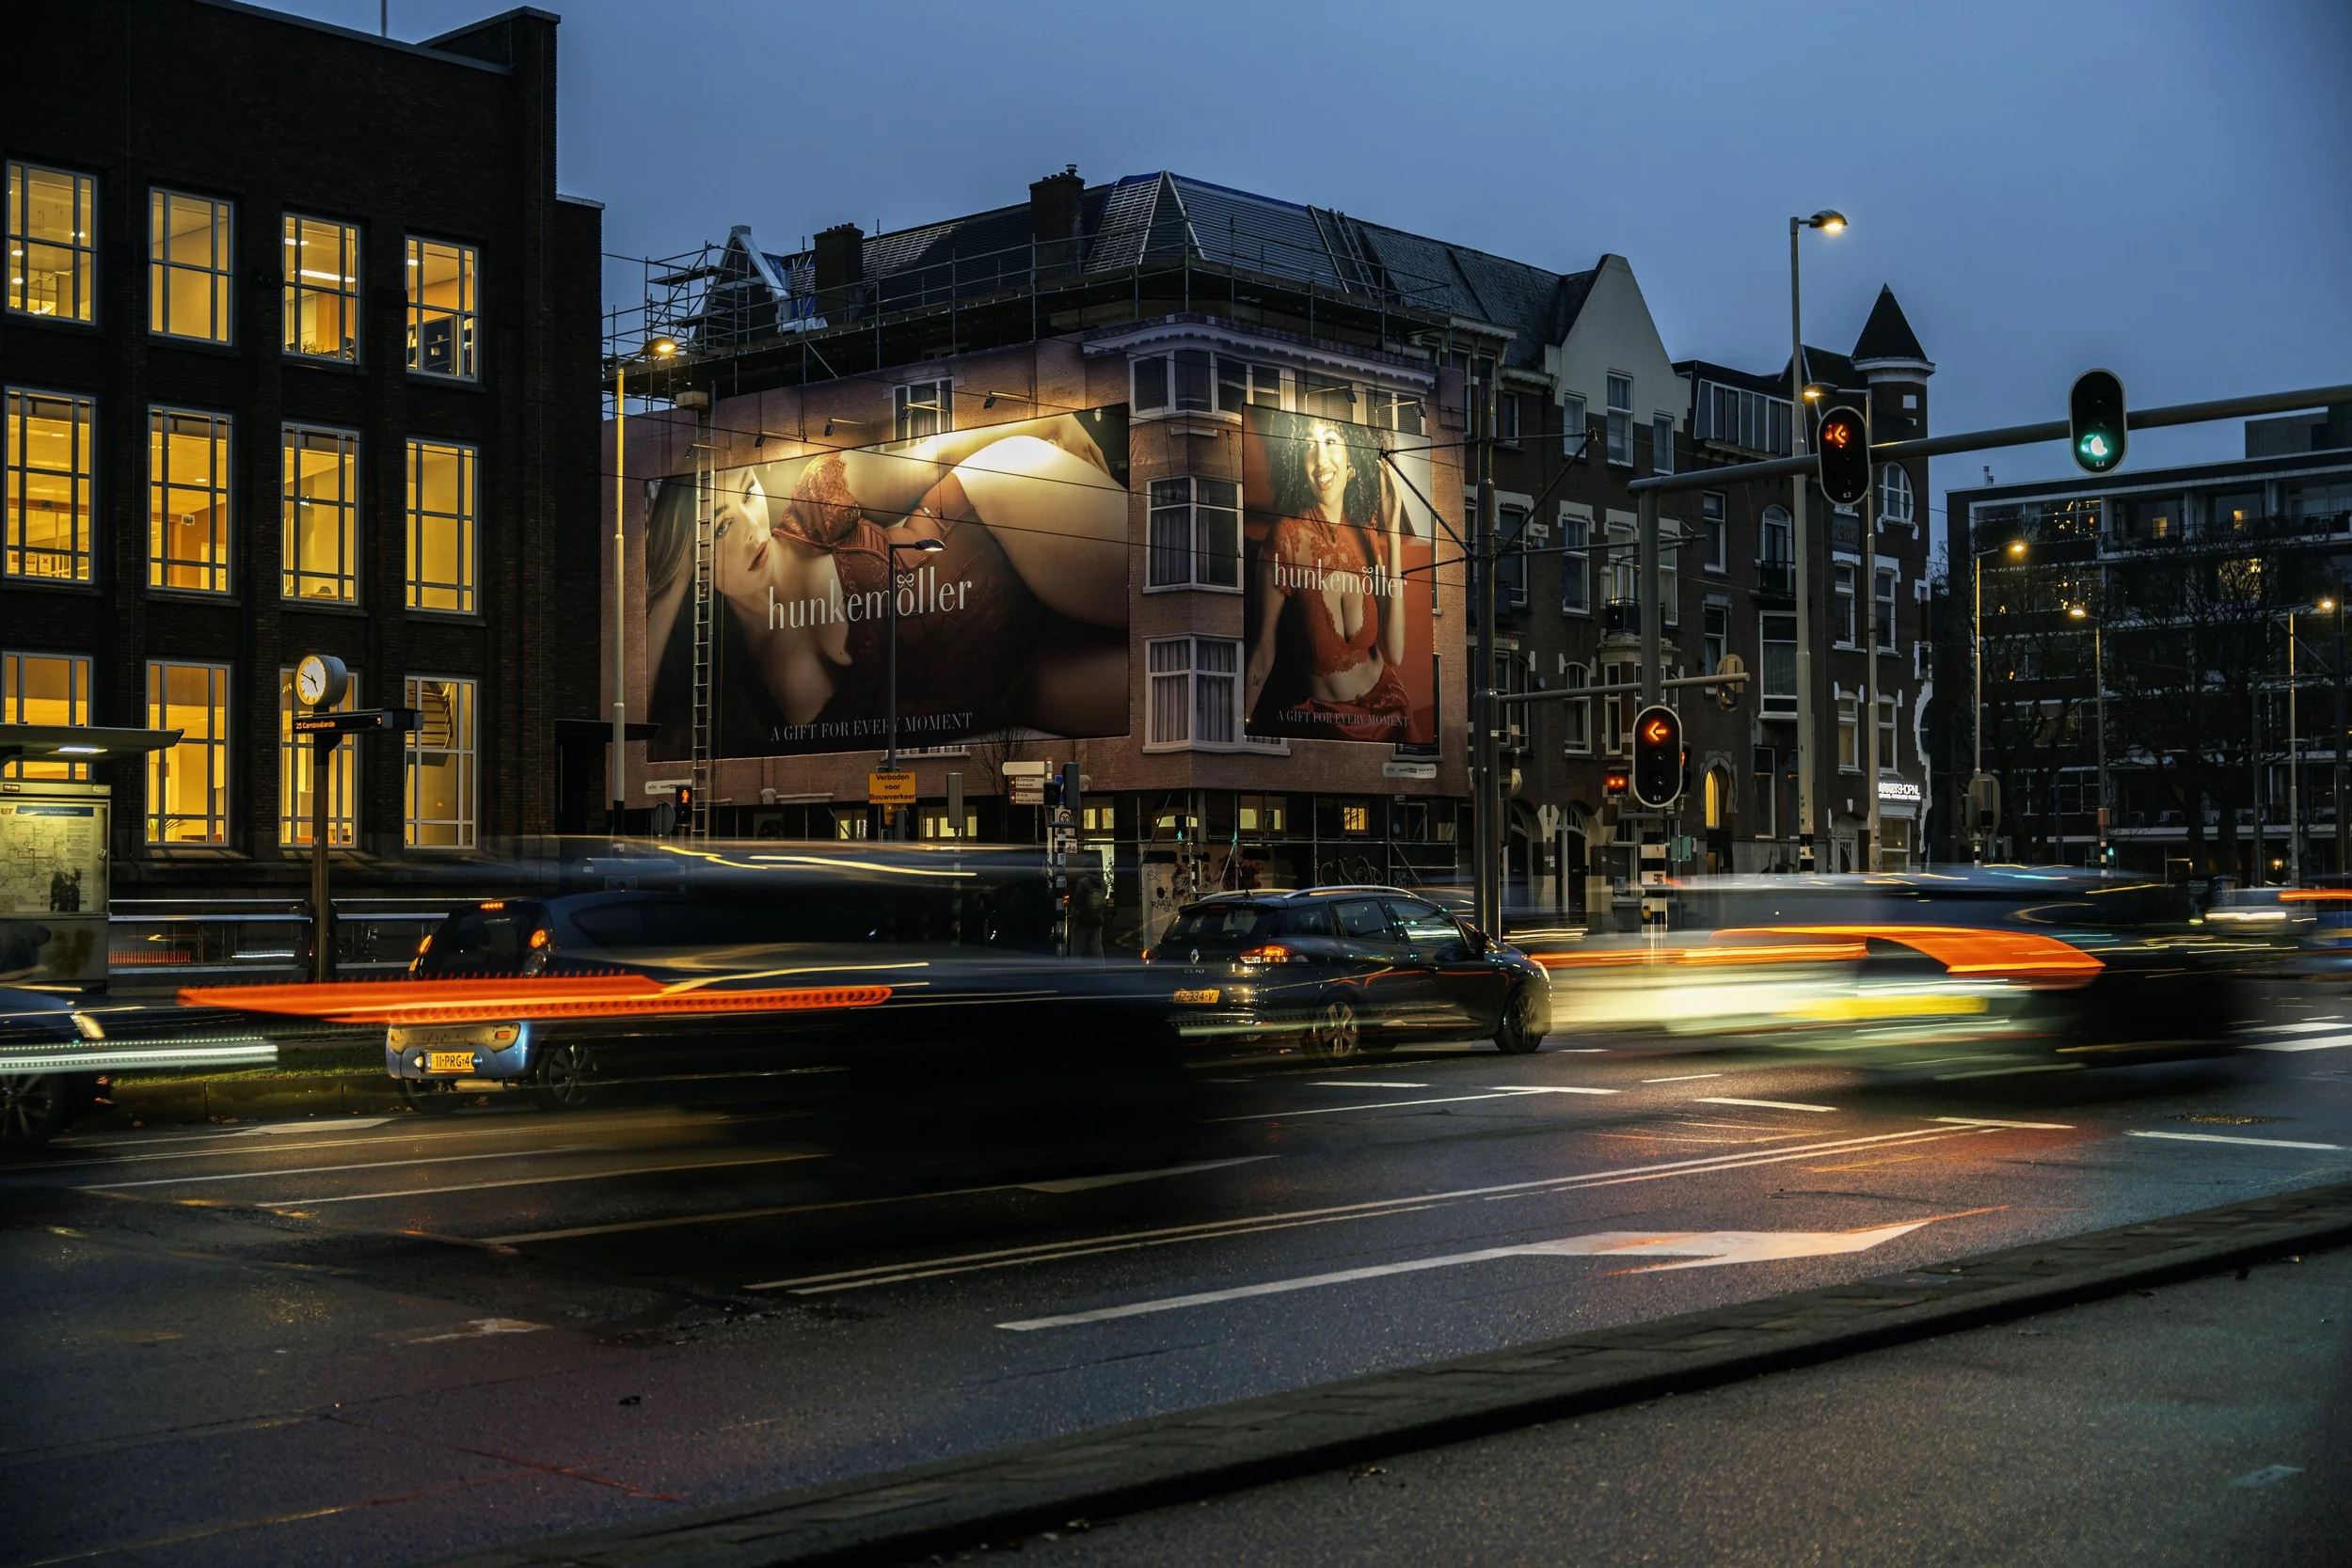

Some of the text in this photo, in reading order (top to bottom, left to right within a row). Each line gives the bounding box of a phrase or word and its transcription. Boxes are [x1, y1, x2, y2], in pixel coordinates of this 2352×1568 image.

[771, 726, 780, 741] A
[784, 723, 817, 741] GIFT
[821, 720, 849, 738] FOR
[905, 712, 973, 733] MOMENT
[1277, 709, 1409, 727] A GIFT FOR EVERY MOMENT
[1176, 991, 1216, 1002] JZ-334-V
